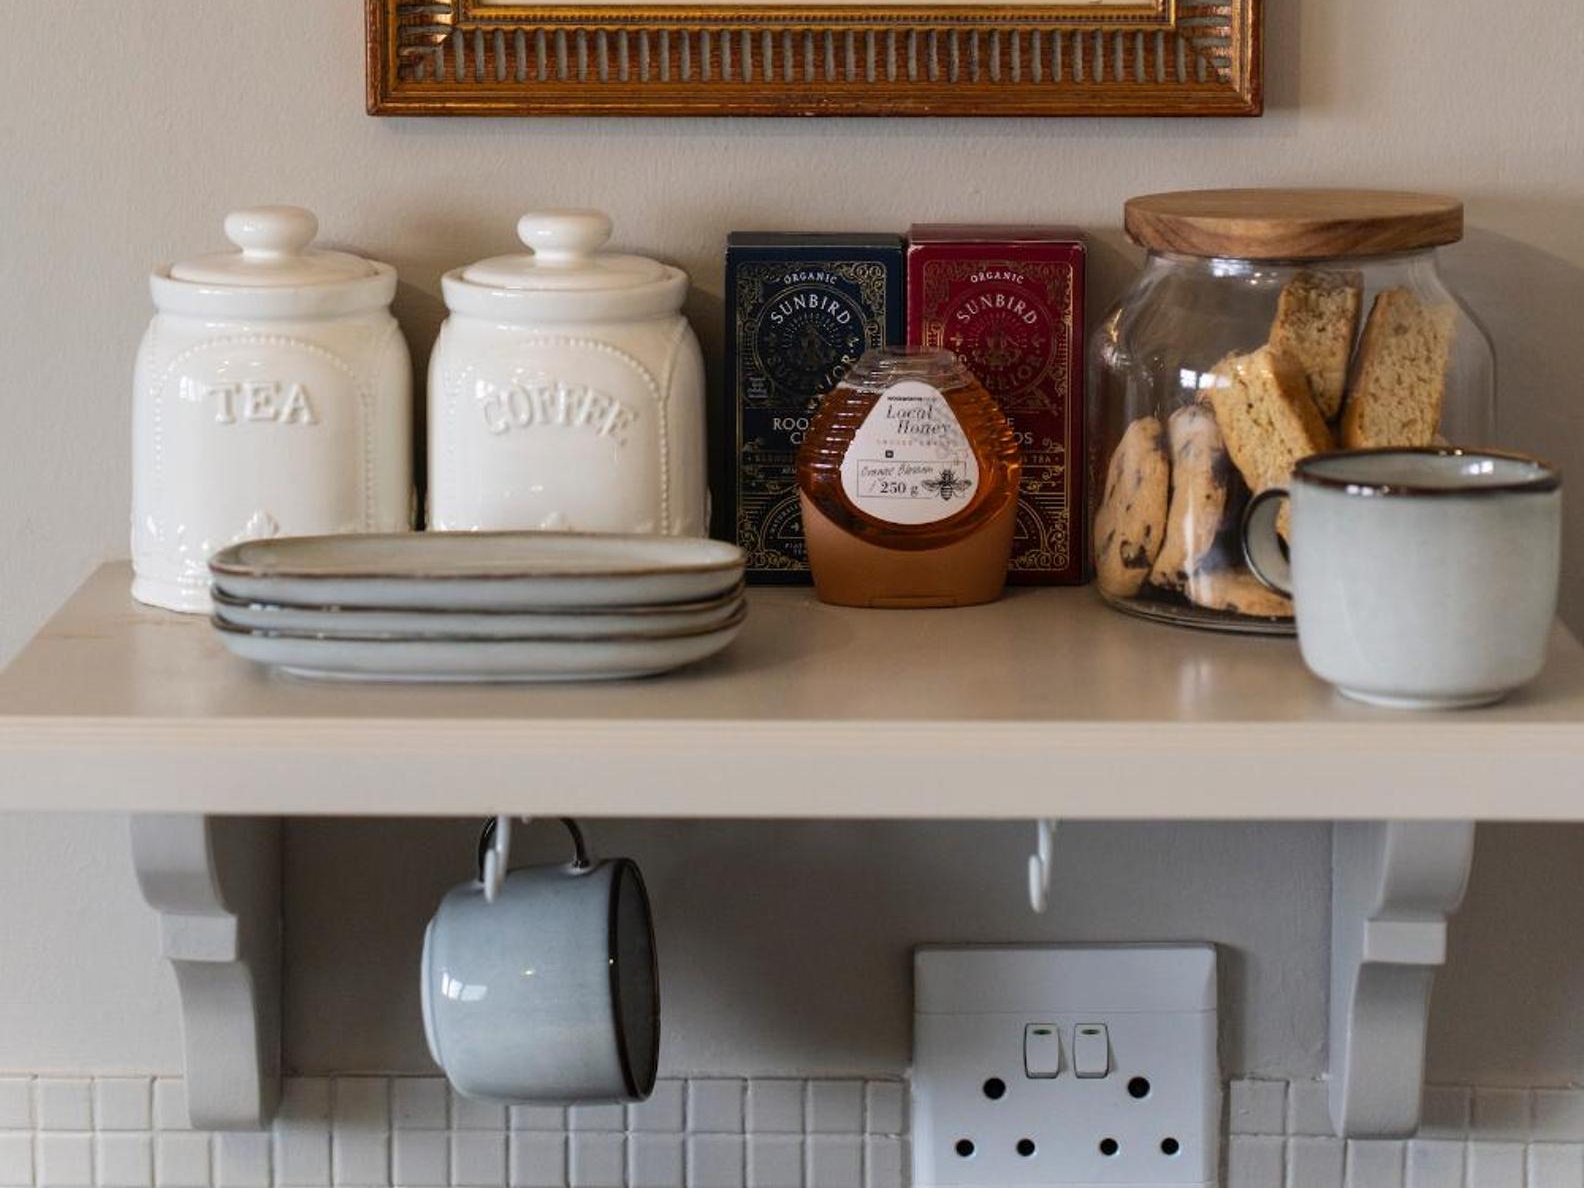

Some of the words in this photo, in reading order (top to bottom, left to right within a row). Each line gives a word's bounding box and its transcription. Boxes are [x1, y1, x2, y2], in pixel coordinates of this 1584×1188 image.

[783, 271, 838, 285] ORGANIC
[970, 271, 1025, 285] ORGANIC
[770, 293, 851, 324] SUNBIRD
[956, 293, 1038, 324] SUNBIRD
[207, 381, 321, 426] TEA
[886, 403, 933, 420] Local
[483, 380, 638, 447] COFFEE
[896, 419, 952, 438] Honey
[879, 481, 908, 495] 250
[909, 484, 920, 499] g
